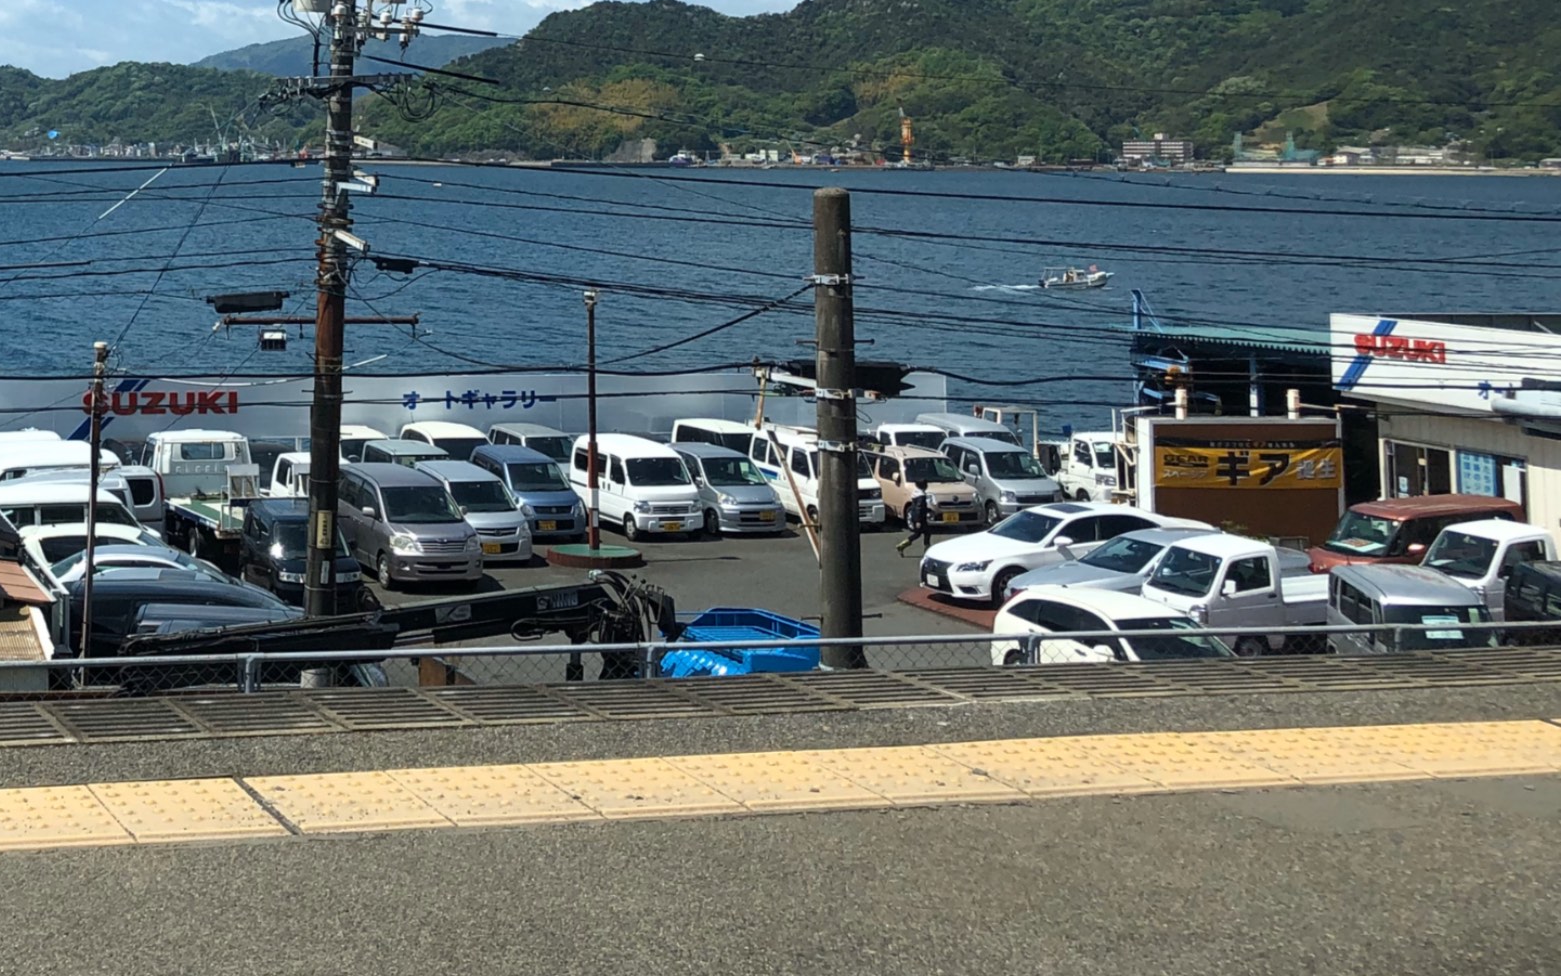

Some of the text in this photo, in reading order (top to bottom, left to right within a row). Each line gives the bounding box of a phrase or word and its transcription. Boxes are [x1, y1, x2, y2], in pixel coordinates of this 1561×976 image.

[1354, 333, 1446, 364] SUZUKI
[83, 390, 238, 415] SUZUKI
[1216, 451, 1291, 486] ギア
